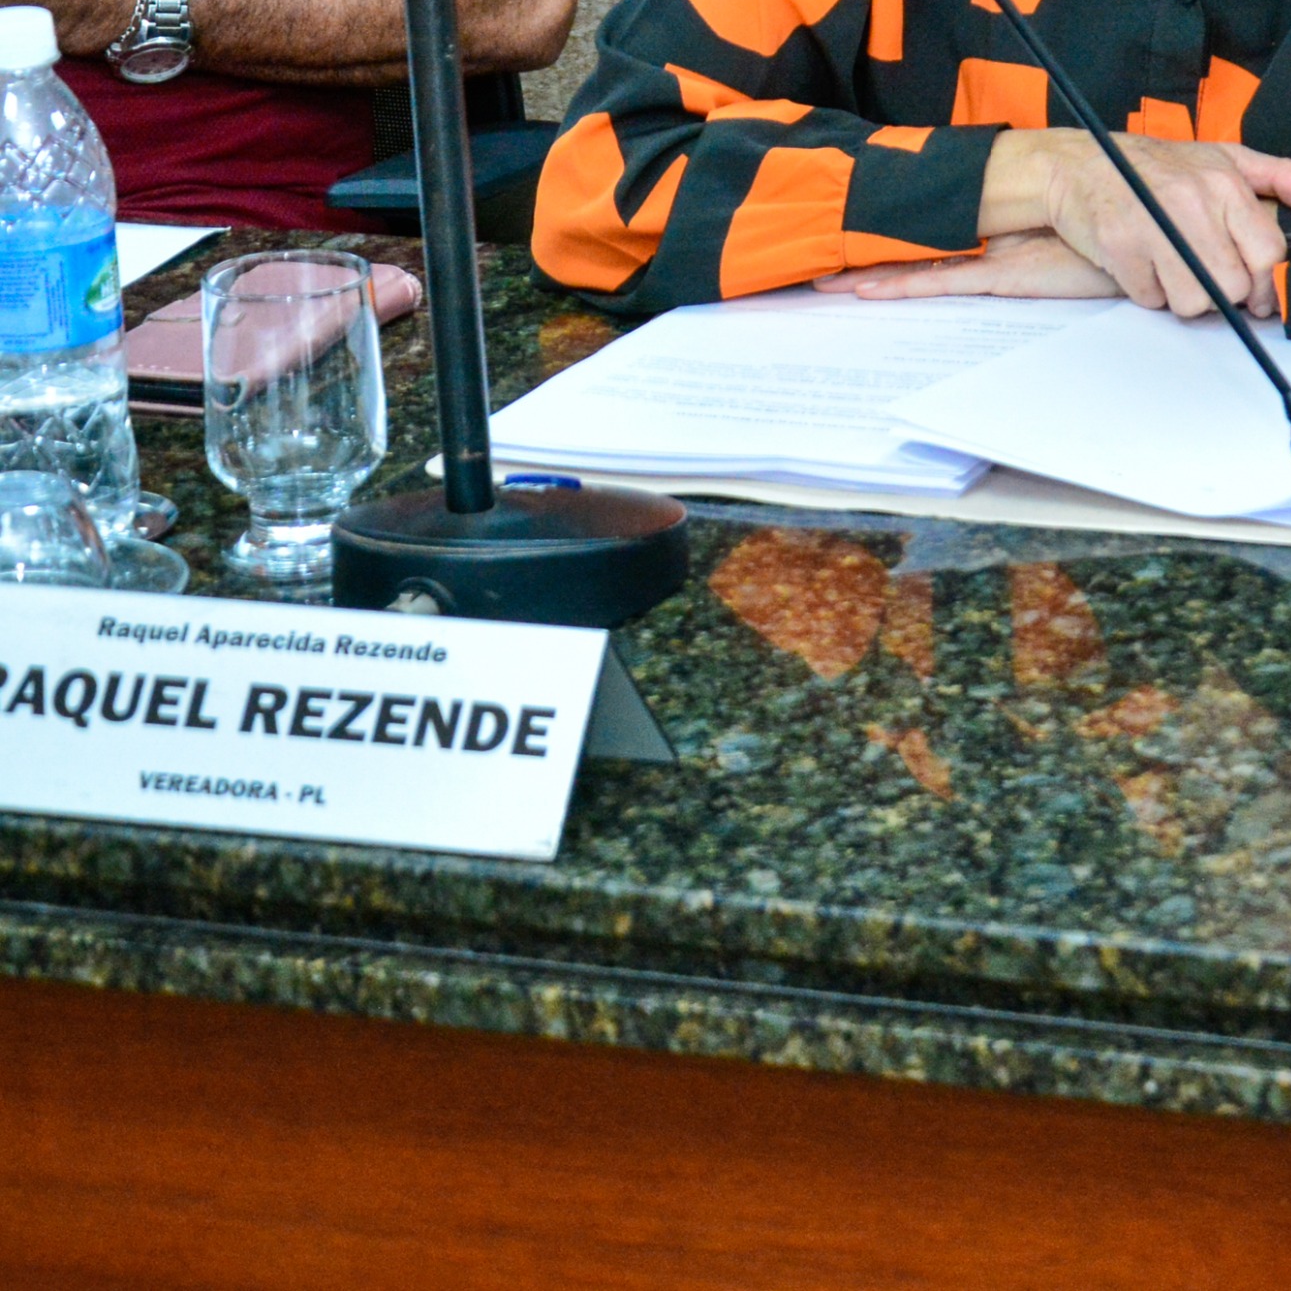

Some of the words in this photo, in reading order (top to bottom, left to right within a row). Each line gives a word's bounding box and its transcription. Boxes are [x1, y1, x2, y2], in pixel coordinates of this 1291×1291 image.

[97, 616, 189, 645] Raquel
[195, 624, 326, 655] Aparecida
[334, 635, 448, 664] Rezende
[0, 663, 217, 729] AQUEL
[239, 684, 557, 758] REZENDE
[140, 771, 278, 801] VEREADORA
[298, 784, 326, 805] PL
